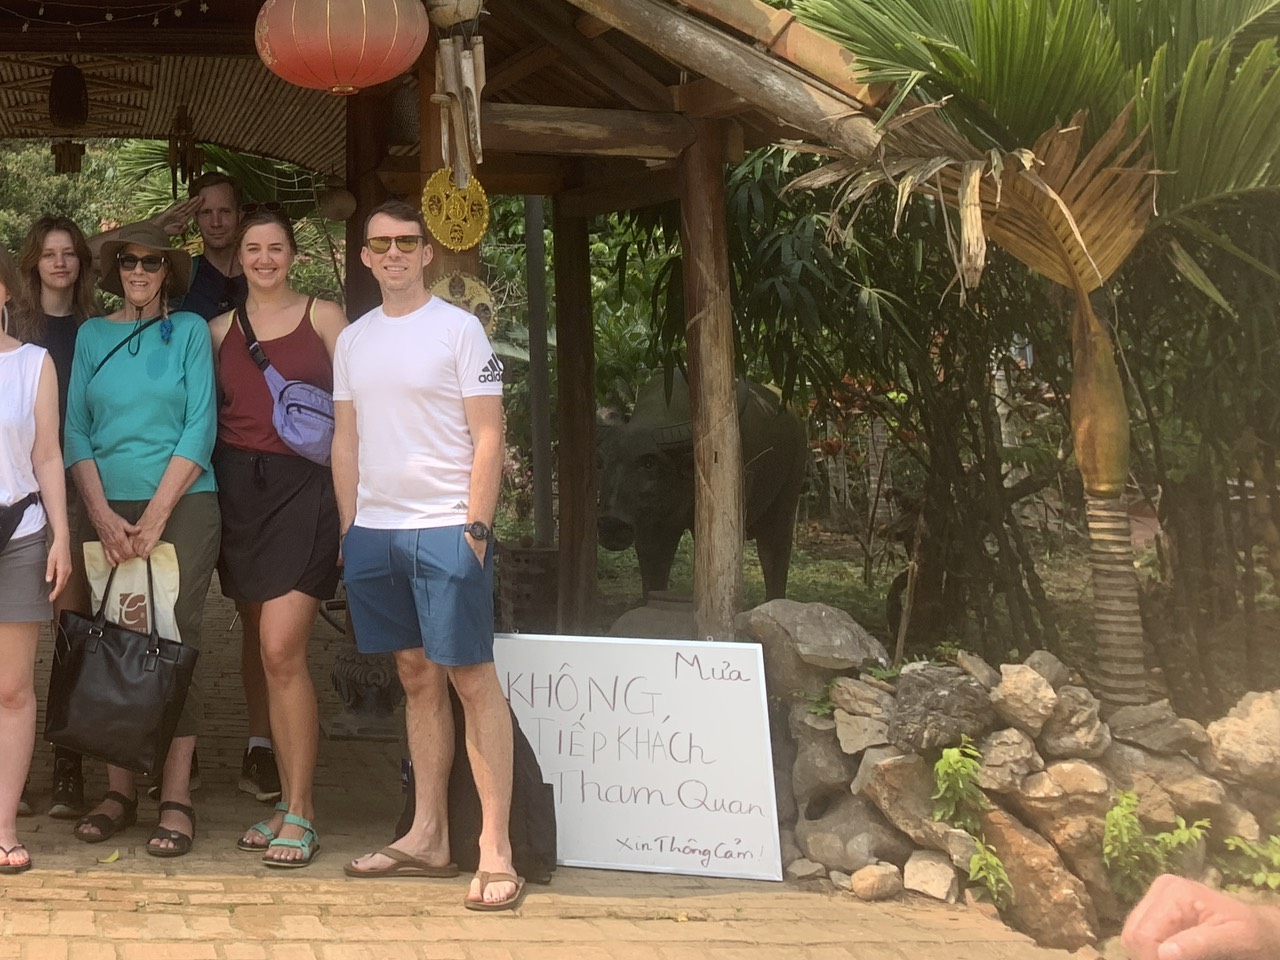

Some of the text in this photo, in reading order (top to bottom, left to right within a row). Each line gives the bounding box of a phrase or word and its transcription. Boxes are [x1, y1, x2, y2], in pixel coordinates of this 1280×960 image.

[506, 662, 663, 716] KHÔNG
[531, 713, 607, 764] TIẾP
[550, 770, 766, 817] Tham Quan
[616, 836, 652, 855] Xin
[654, 835, 712, 868] Thông
